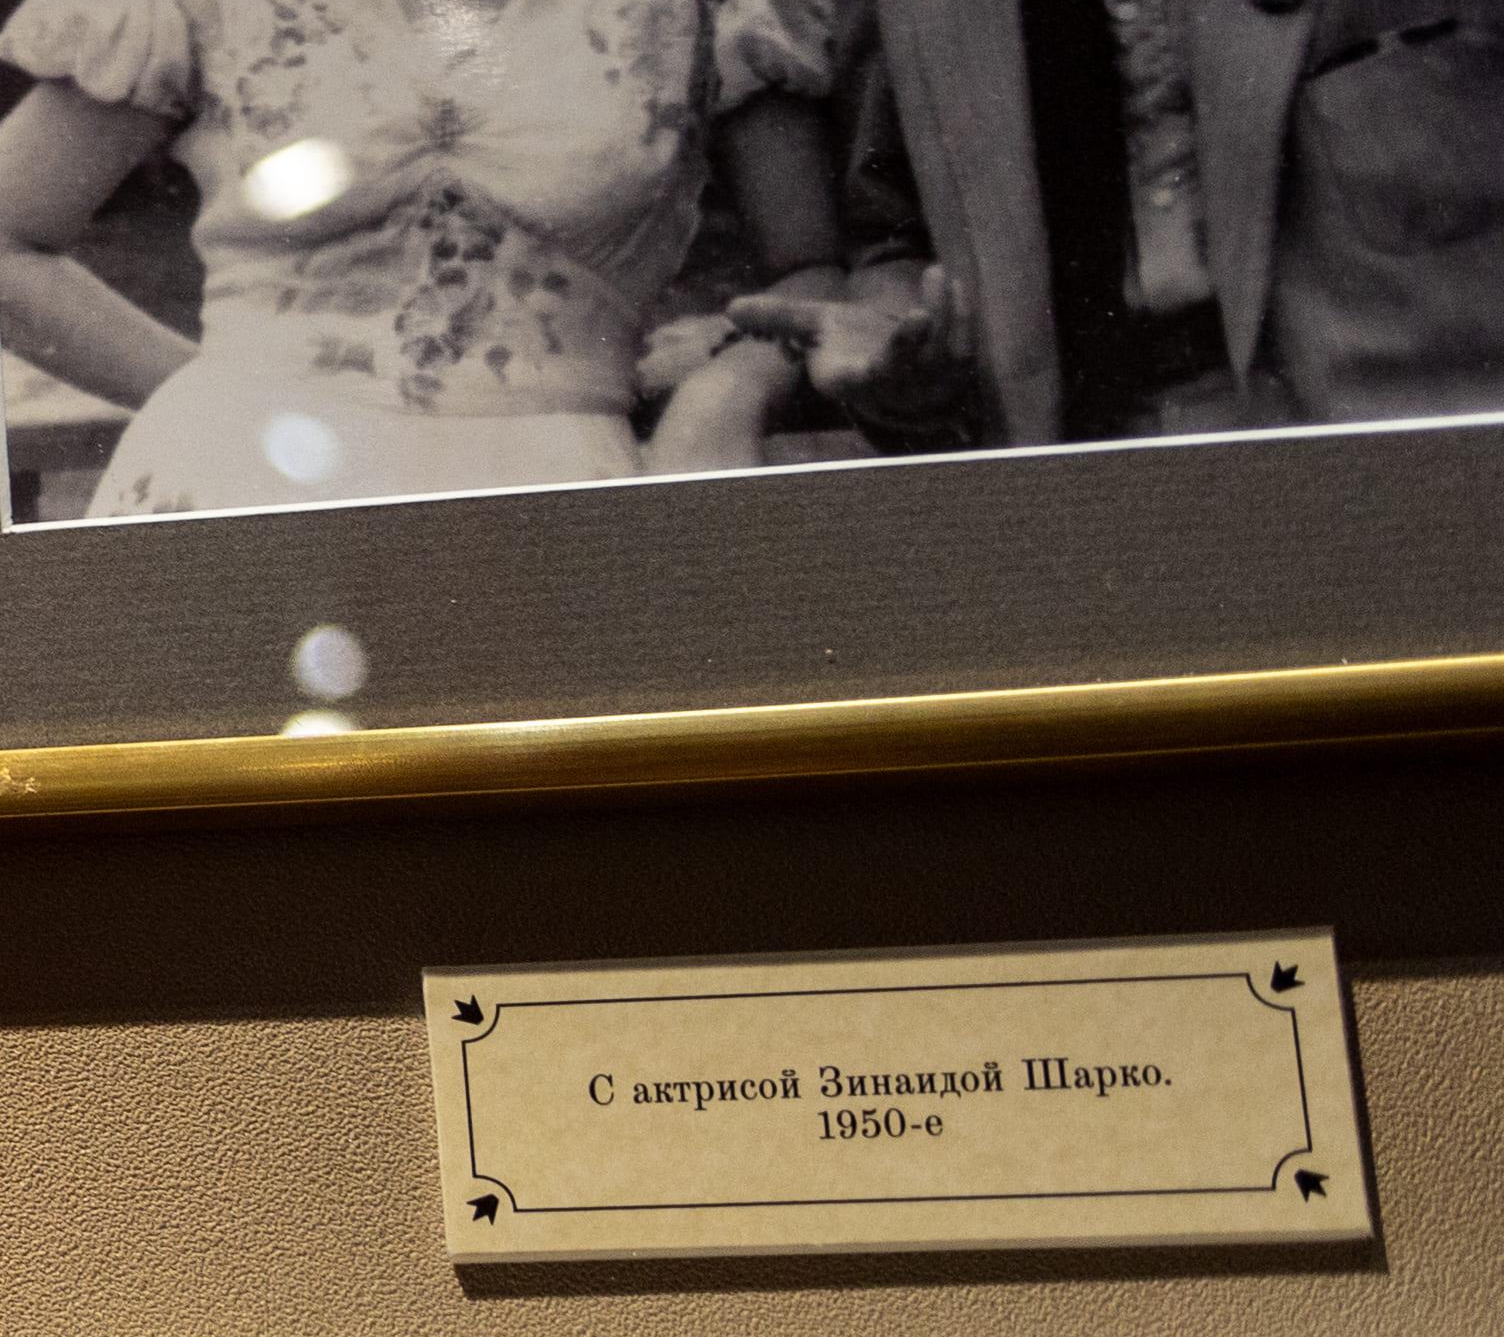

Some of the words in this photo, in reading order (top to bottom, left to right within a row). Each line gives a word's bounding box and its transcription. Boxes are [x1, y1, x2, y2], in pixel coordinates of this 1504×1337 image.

[588, 1073, 615, 1106] С
[632, 1068, 802, 1111] актрисой
[818, 1060, 1004, 1099] Зинаидой
[1020, 1057, 1173, 1098] Шарко.
[817, 1106, 944, 1140] 1950-е
